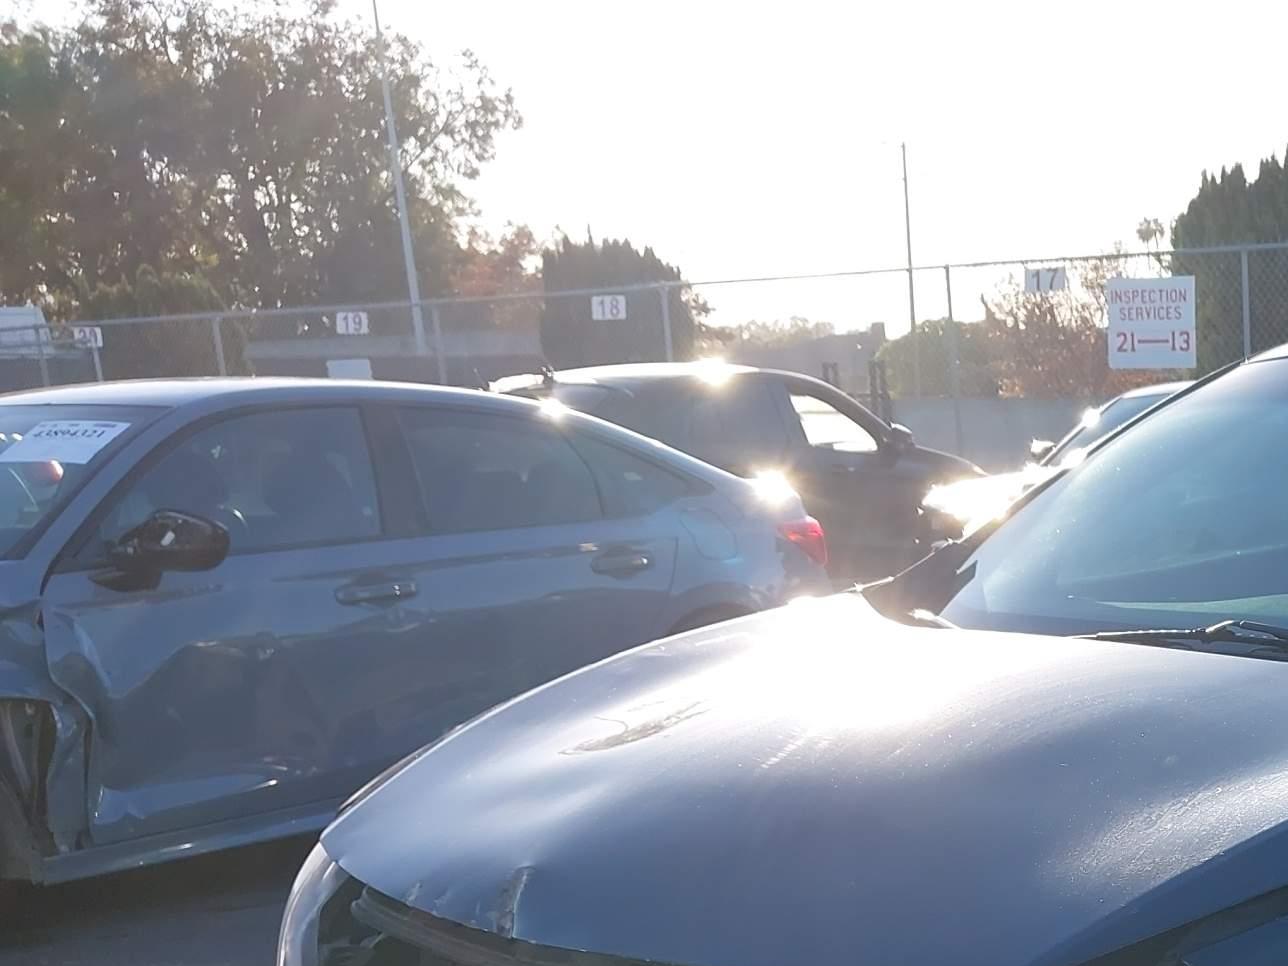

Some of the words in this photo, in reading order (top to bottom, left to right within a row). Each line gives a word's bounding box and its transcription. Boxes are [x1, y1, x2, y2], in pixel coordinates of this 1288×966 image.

[1031, 269, 1060, 290] 17
[1110, 289, 1187, 304] INSPECTION
[599, 297, 620, 318] 18
[1119, 305, 1182, 321] SERVICES
[342, 313, 363, 332] 19
